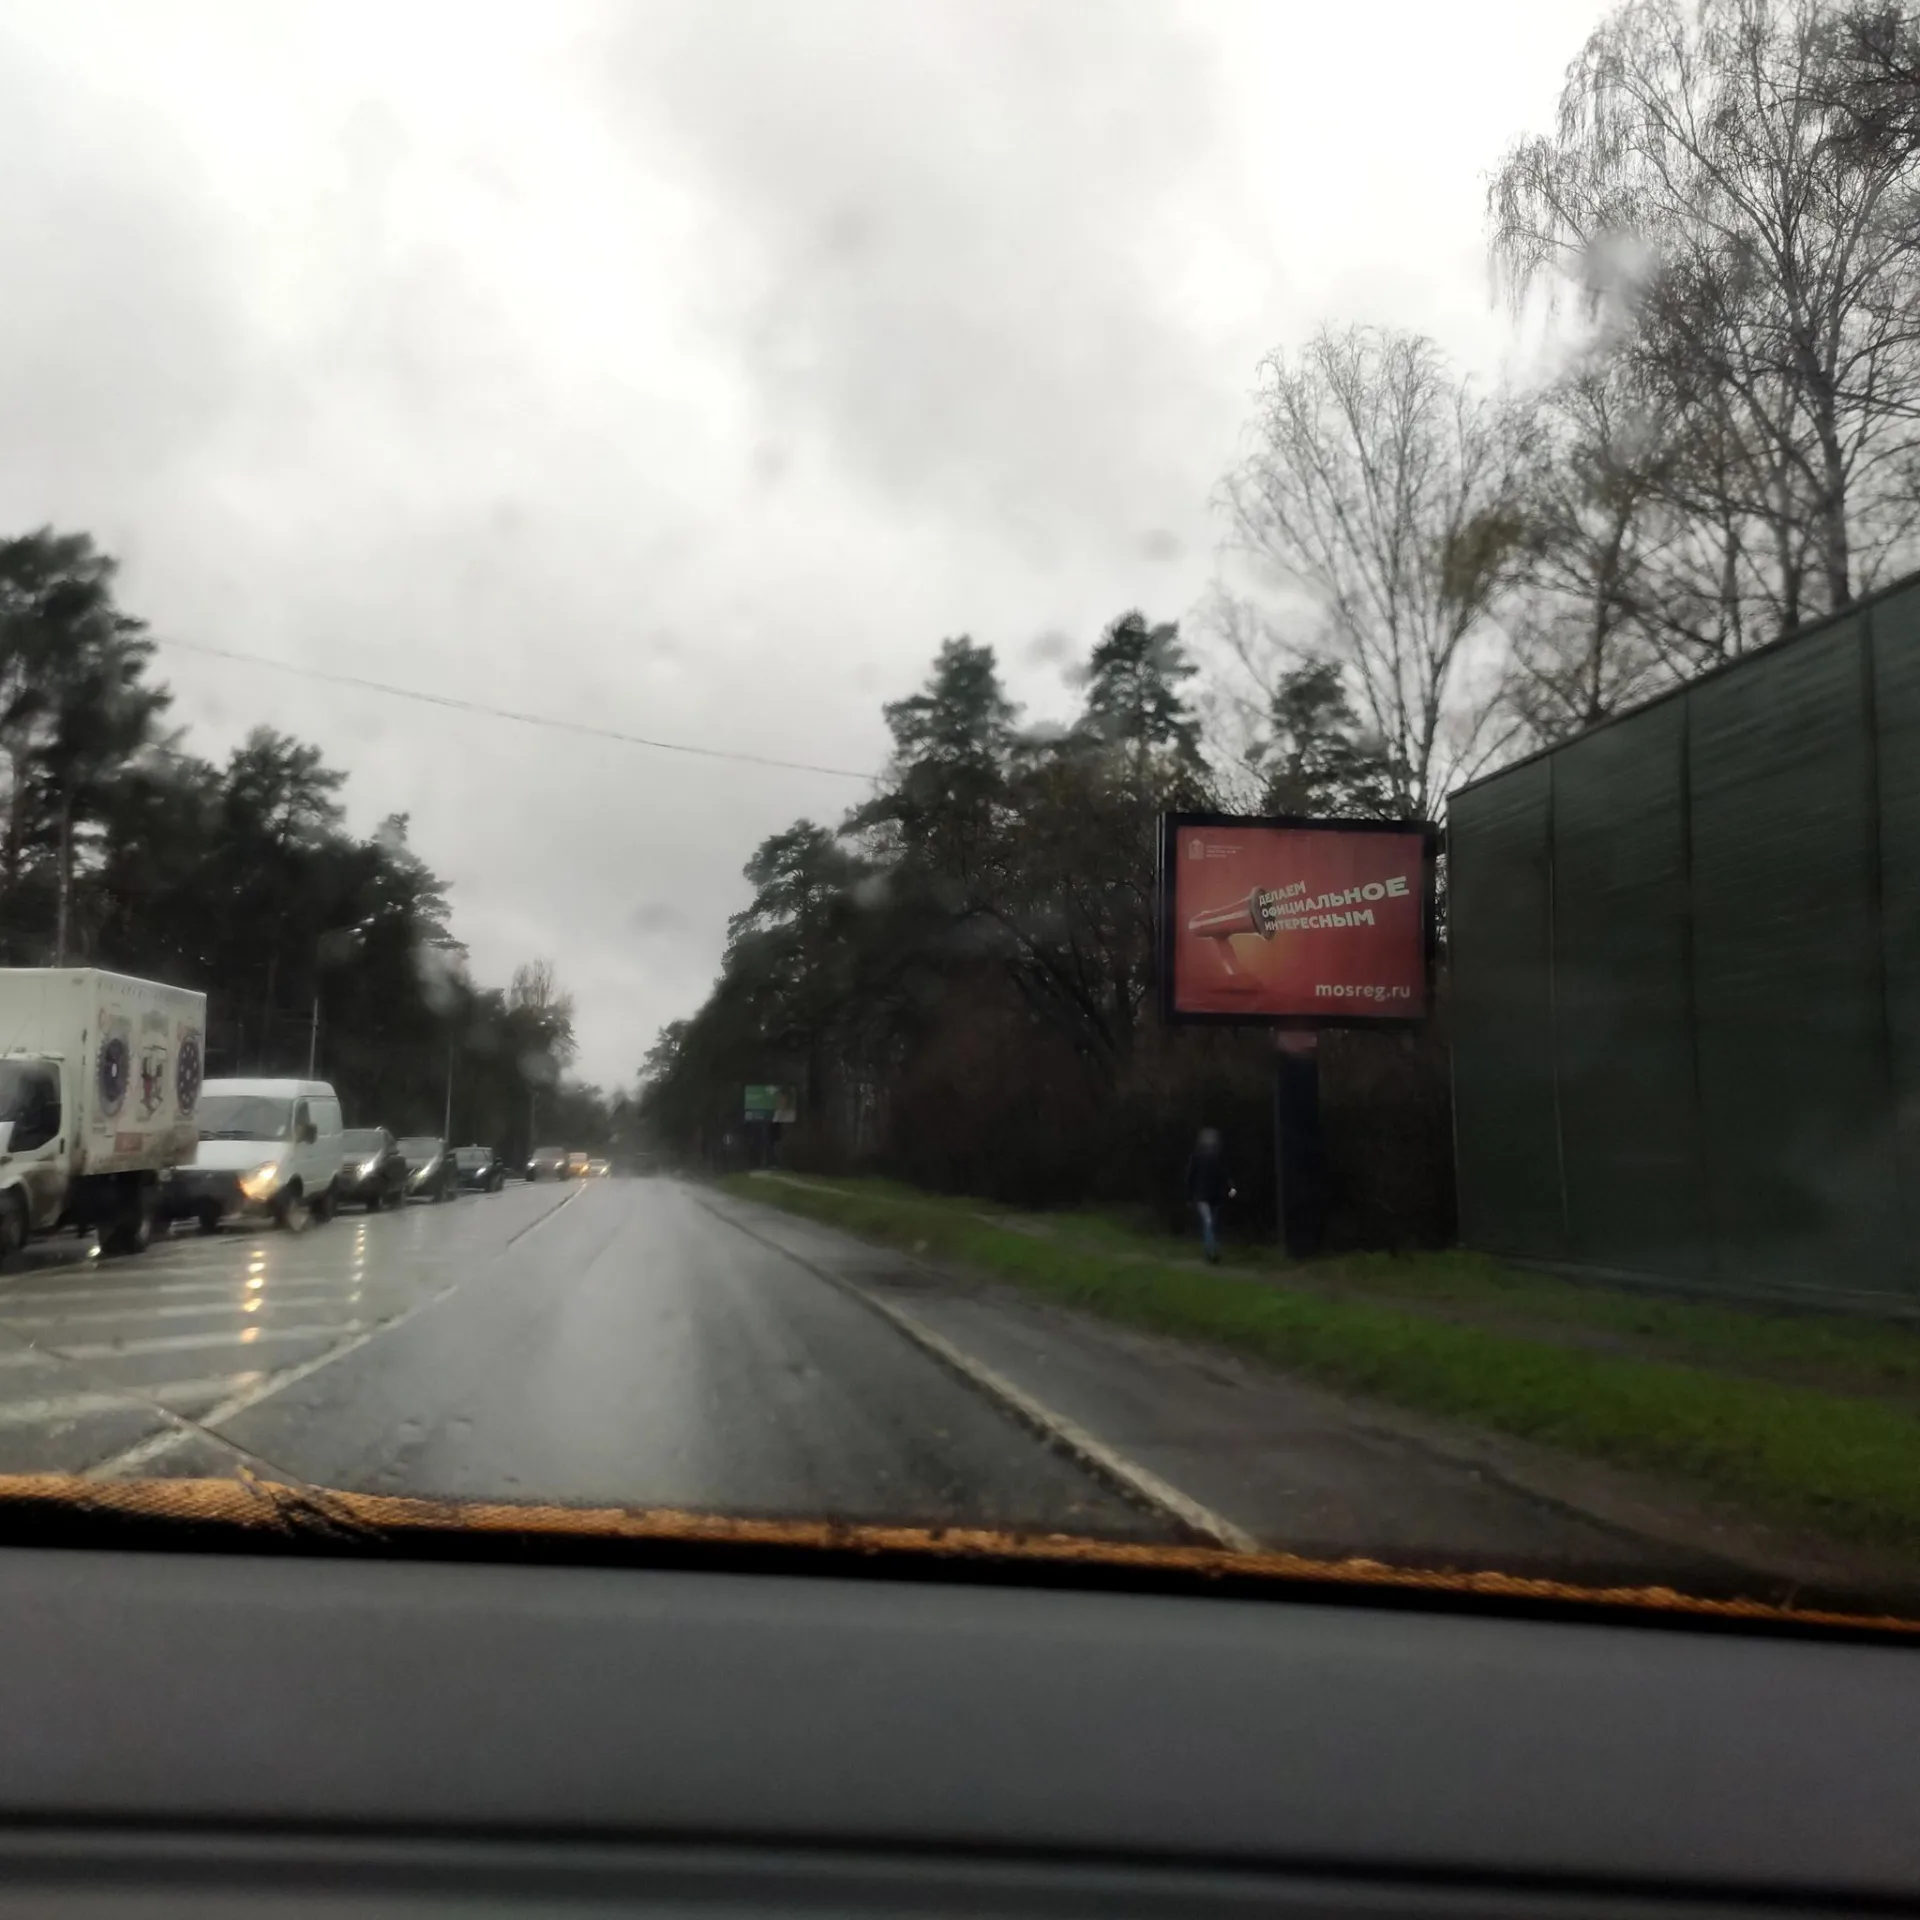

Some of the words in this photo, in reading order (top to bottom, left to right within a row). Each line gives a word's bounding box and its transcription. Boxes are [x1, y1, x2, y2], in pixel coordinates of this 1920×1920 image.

[1259, 880, 1306, 906] ДЕЛАЕМ
[1261, 876, 1410, 918] ОФИЦИАЛЬНОЕ
[1264, 909, 1375, 931] ИНТЕРЕСНЫМ
[1315, 984, 1411, 1001] mosreg.ru
